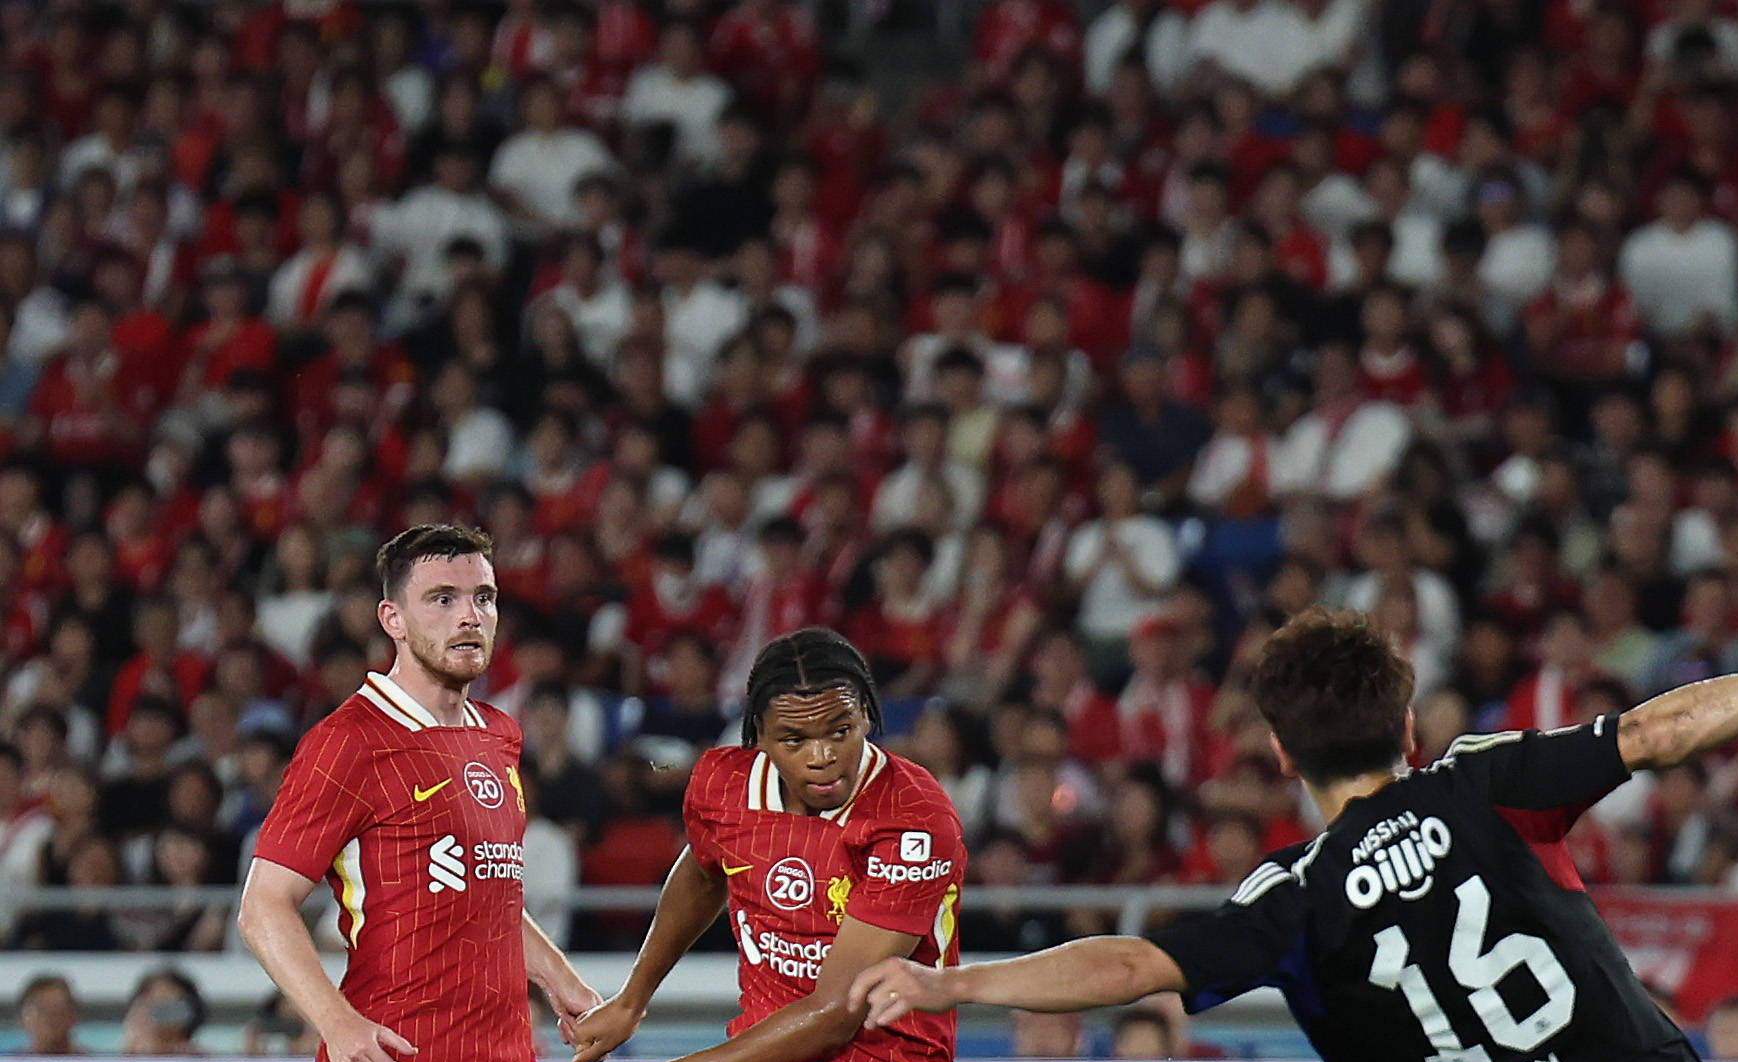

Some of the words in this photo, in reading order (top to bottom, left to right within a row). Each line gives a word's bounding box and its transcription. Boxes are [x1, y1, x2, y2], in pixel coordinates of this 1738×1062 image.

[471, 780, 499, 800] 20
[777, 865, 804, 878] DIOGO
[867, 856, 952, 885] Expedia
[772, 875, 809, 902] 20
